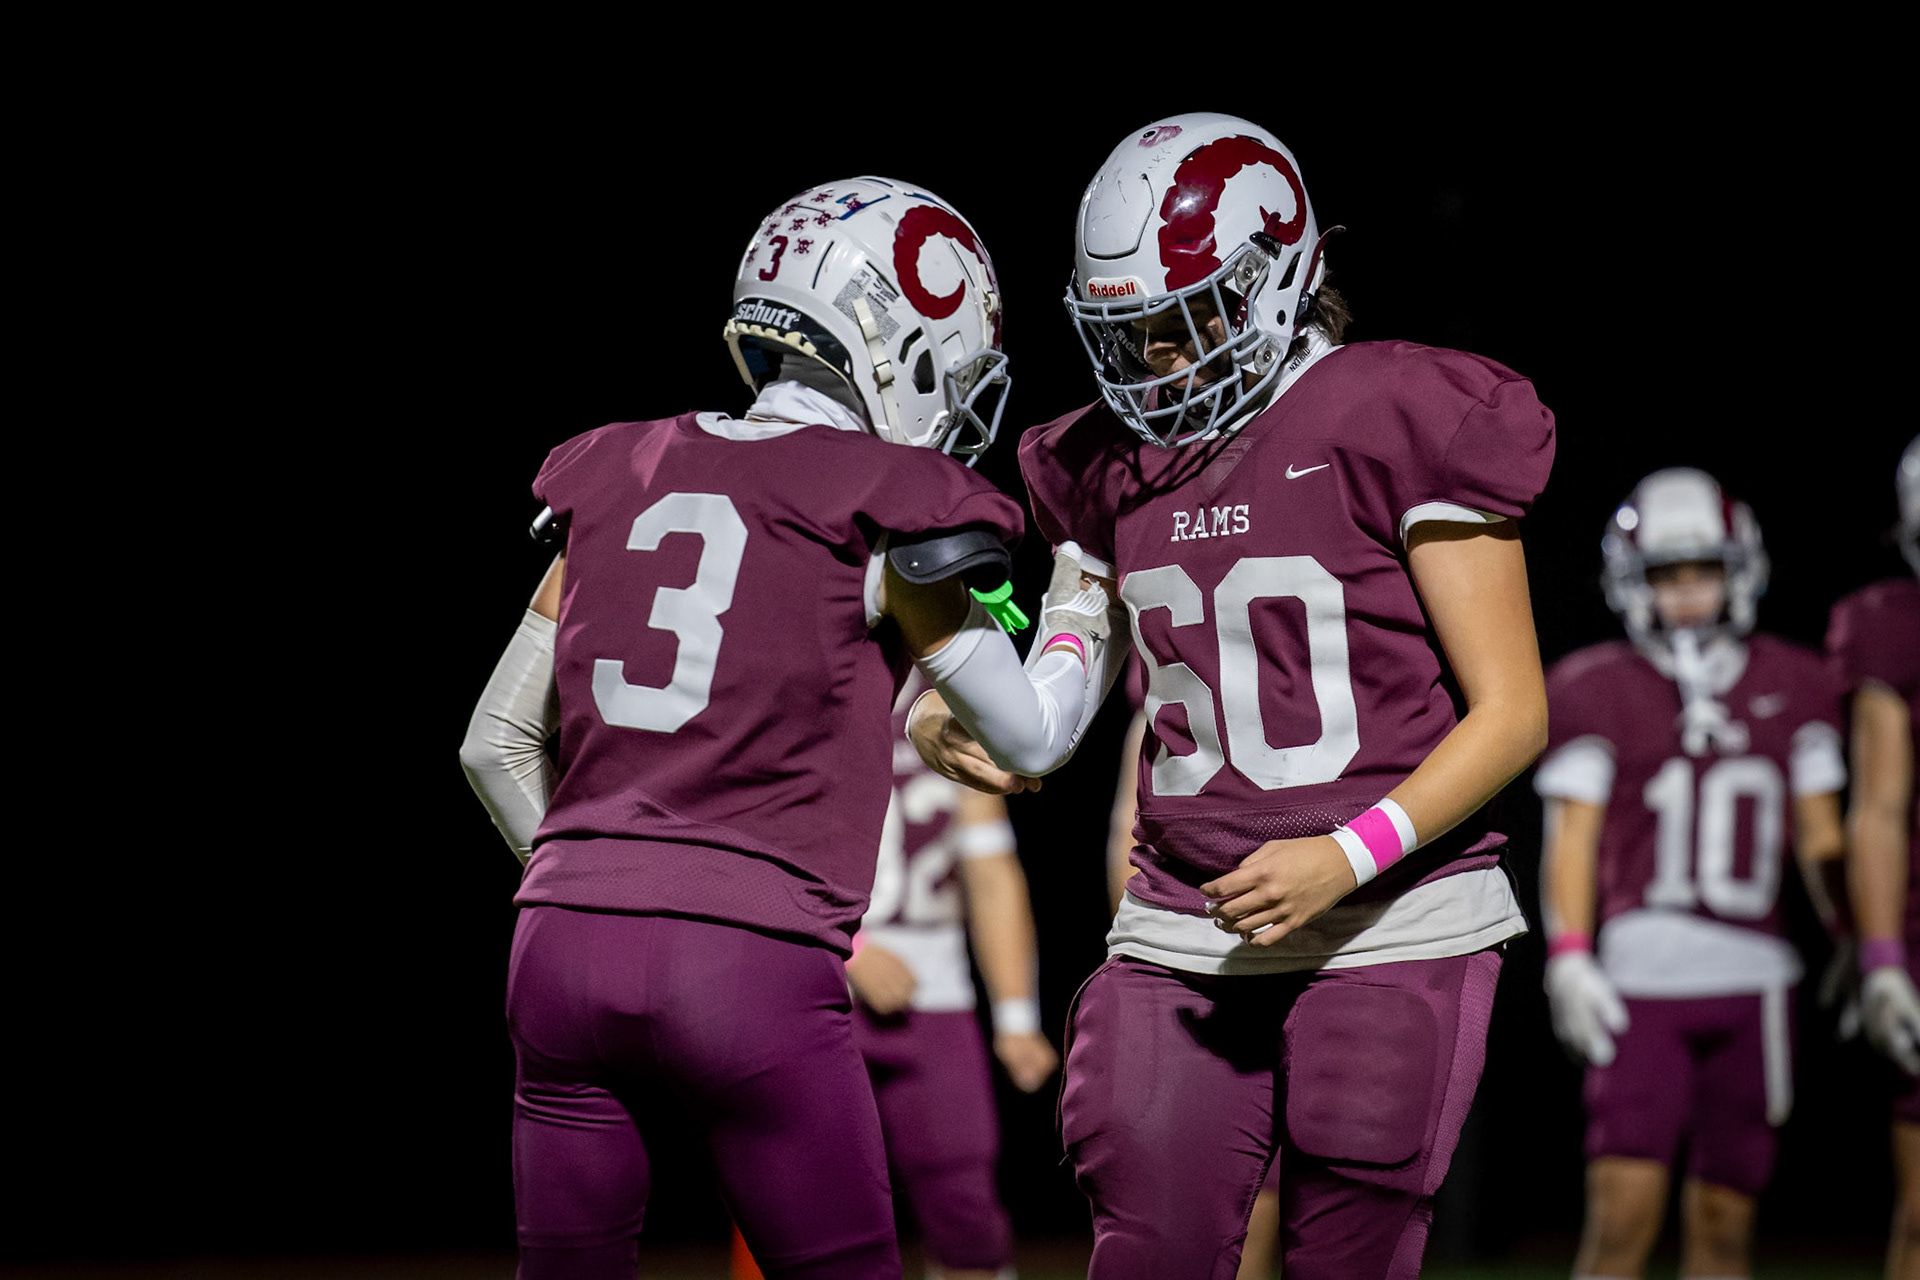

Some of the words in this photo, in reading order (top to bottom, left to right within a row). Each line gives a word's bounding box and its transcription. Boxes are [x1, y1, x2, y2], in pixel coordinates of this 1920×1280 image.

[759, 235, 788, 281] 3
[1088, 281, 1136, 297] Riddell
[735, 299, 798, 330] schutt
[1170, 504, 1250, 542] RAMS
[591, 492, 749, 733] 3
[1120, 555, 1361, 796] 60
[864, 774, 962, 925] 2
[1643, 755, 1785, 921] 10
